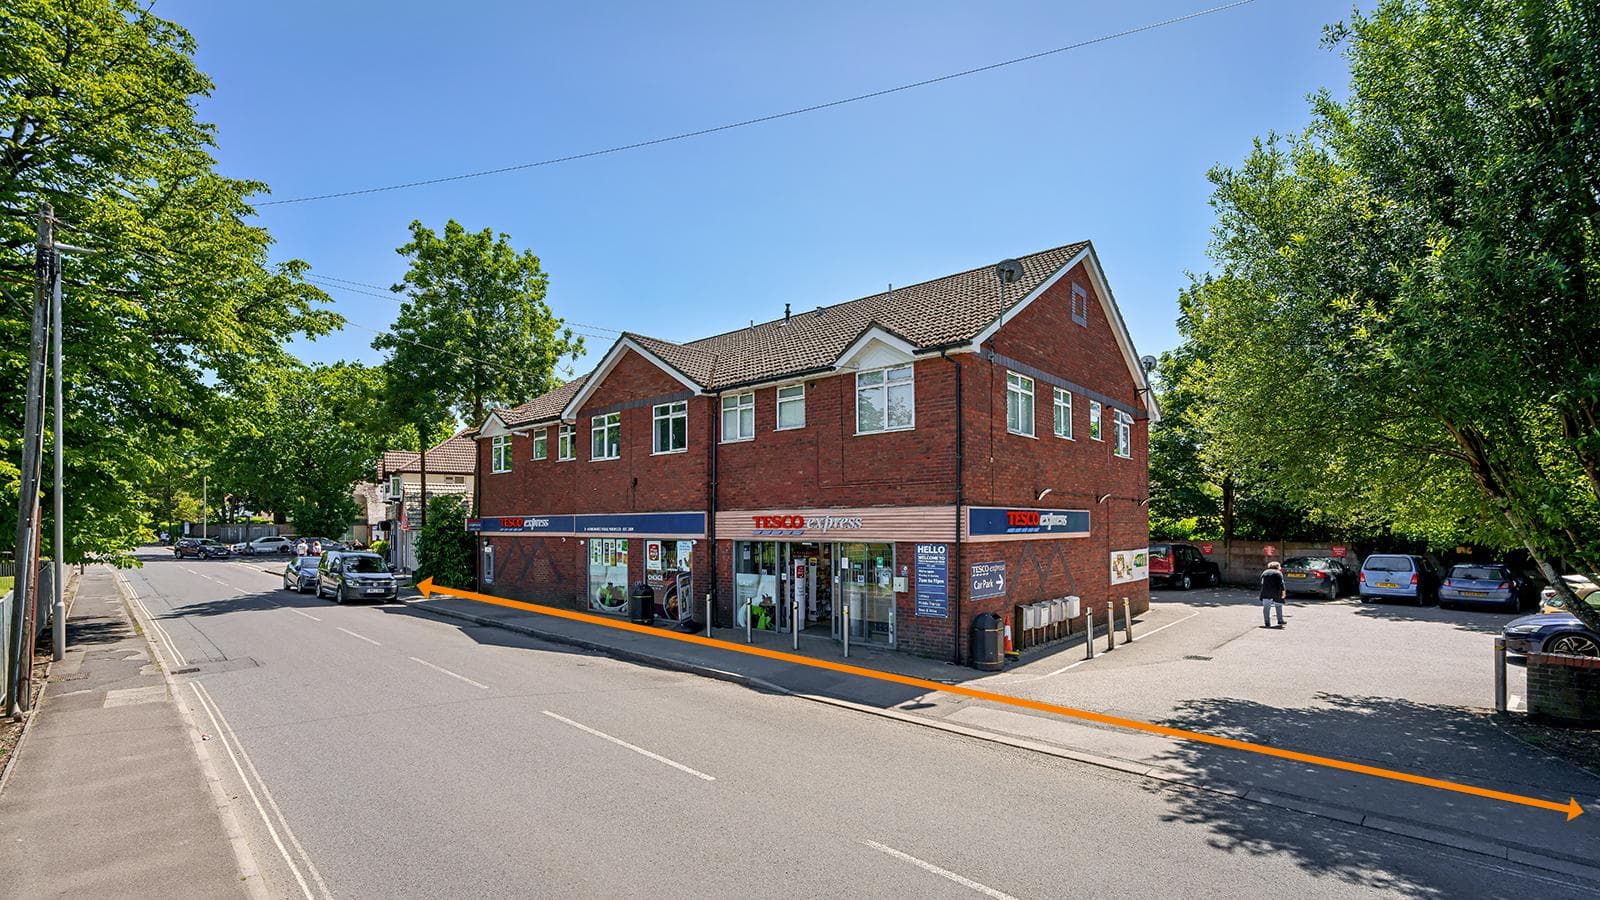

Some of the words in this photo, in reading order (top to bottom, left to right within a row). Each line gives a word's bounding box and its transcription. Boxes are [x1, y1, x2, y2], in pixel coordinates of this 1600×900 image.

[500, 518, 523, 527] TESCO
[524, 518, 549, 530] express
[752, 515, 805, 529] TESCO
[806, 515, 862, 534] express
[1007, 511, 1040, 526] TESCO
[1040, 512, 1067, 530] express
[918, 546, 945, 554] HELLO
[972, 565, 989, 573] TESCO
[974, 580, 983, 590] Car
[983, 580, 993, 588] Park
